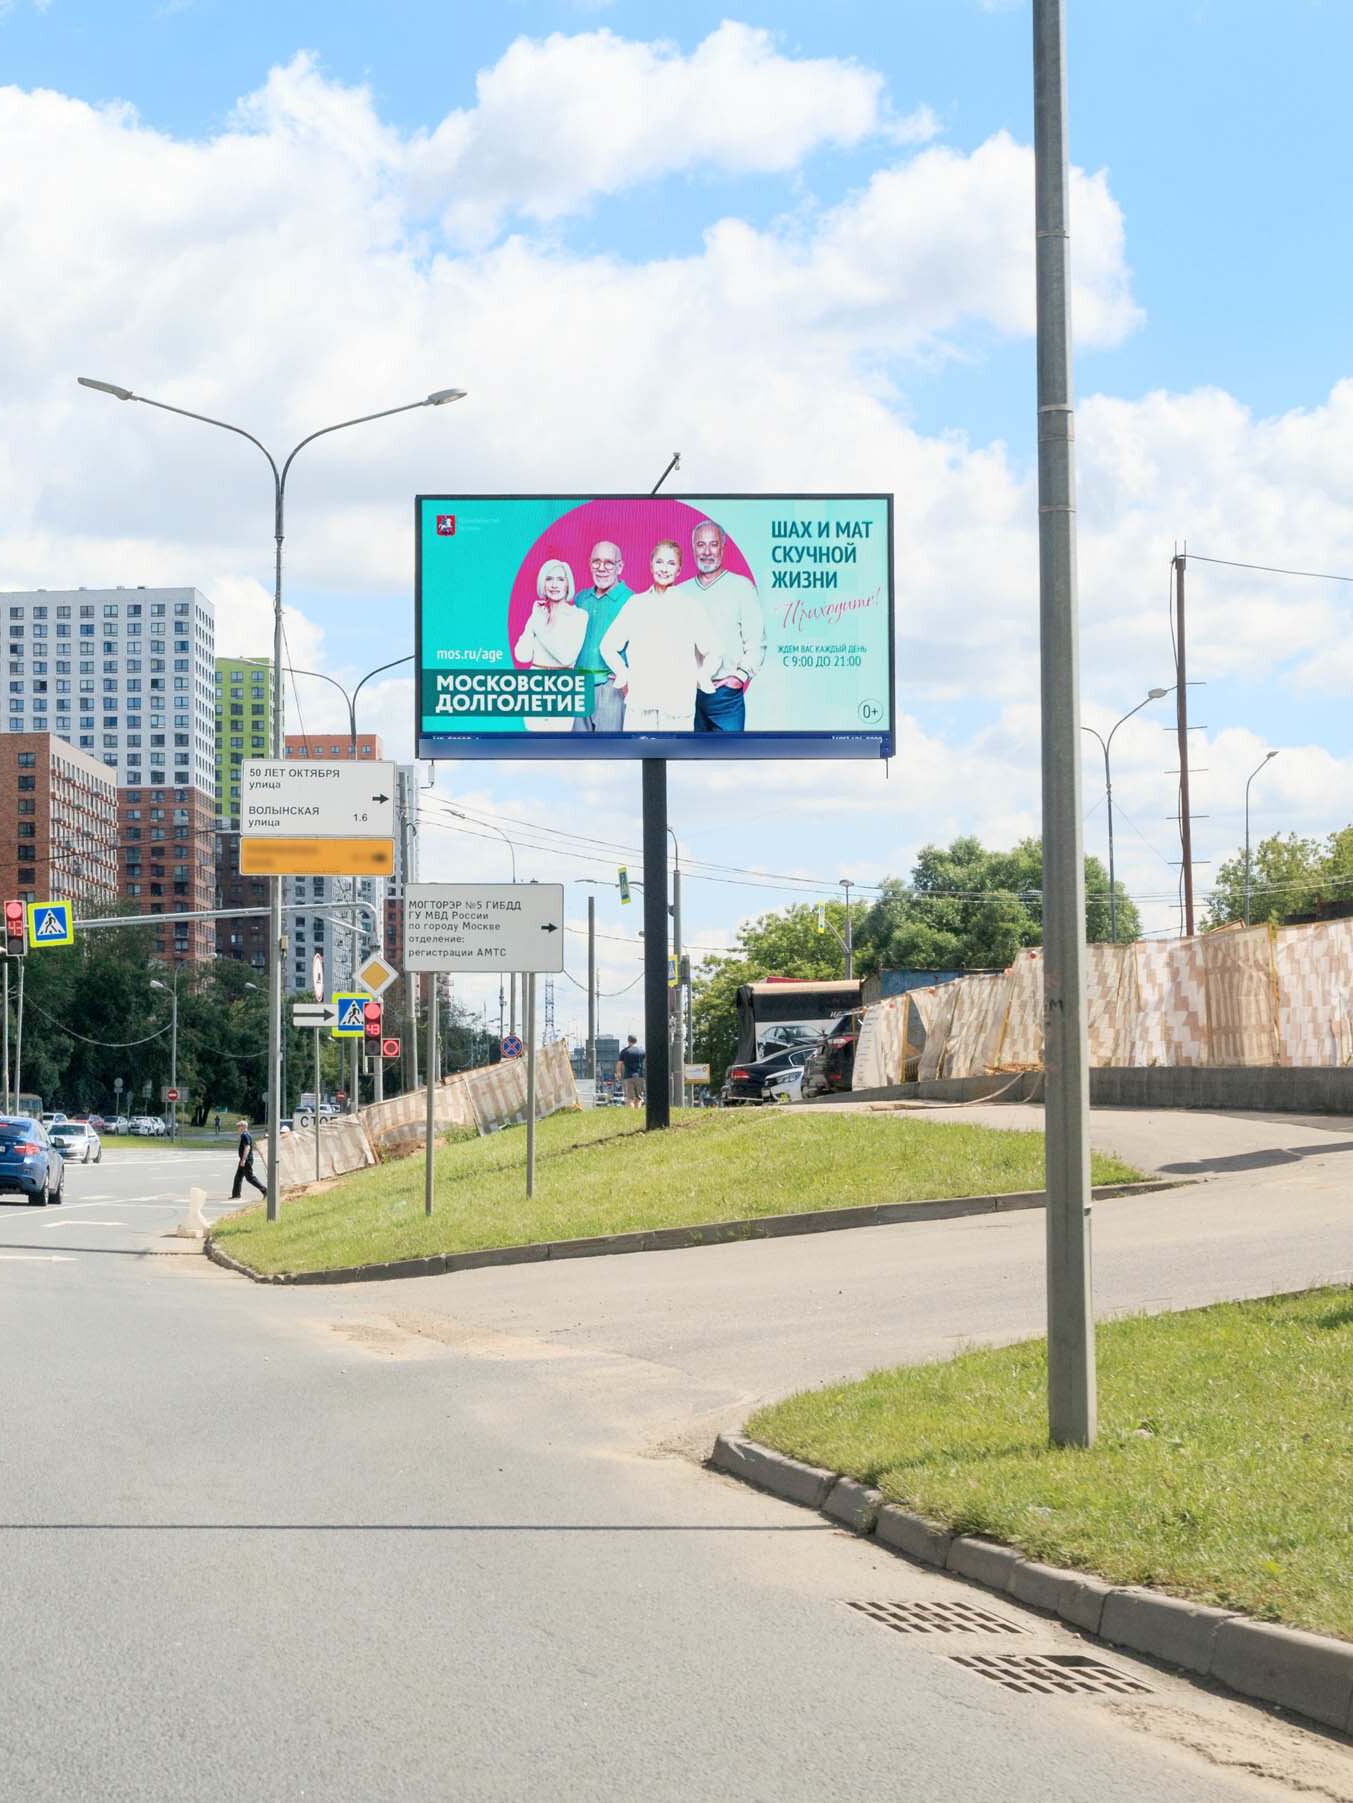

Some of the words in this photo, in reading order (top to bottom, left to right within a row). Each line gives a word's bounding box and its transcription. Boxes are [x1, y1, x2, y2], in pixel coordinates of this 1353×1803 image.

[771, 520, 813, 538] ШАХ
[817, 520, 830, 538] И
[835, 520, 873, 538] МАТ
[771, 542, 857, 563] СКУЧНОЙ
[771, 570, 838, 589] ЖИЗНИ
[800, 645, 814, 654] ВАС
[815, 644, 847, 654] КАЖДЫЙ
[848, 645, 868, 654] ДЕНЬ
[436, 647, 504, 664] mos.ru/age
[782, 655, 789, 667] С
[791, 655, 814, 667] 9:00
[815, 655, 831, 668] ДО
[833, 655, 862, 667] 21:00
[436, 674, 586, 692] МОСКОВСКОЕ
[435, 694, 586, 713] ДОЛГОЛЕТИЕ
[862, 704, 879, 719] 0+
[249, 768, 262, 777] 50
[264, 768, 286, 777] ЛЕТ
[288, 768, 341, 778] ОКТЯБРЯ
[248, 781, 281, 790] улица
[248, 806, 320, 816] ВОЛЫНСКАЯ
[353, 813, 369, 822] 1.6
[248, 819, 281, 829] улица
[408, 900, 463, 909] МОГТОРЭР
[485, 900, 523, 911] ГИБДД
[408, 911, 421, 920] ГУ
[425, 911, 449, 920] МВД
[451, 911, 489, 920] России
[423, 923, 459, 932] городу
[462, 921, 501, 931] Москве
[408, 936, 465, 944] отделение:
[408, 949, 473, 958] регистрации
[476, 948, 507, 957] АМТС
